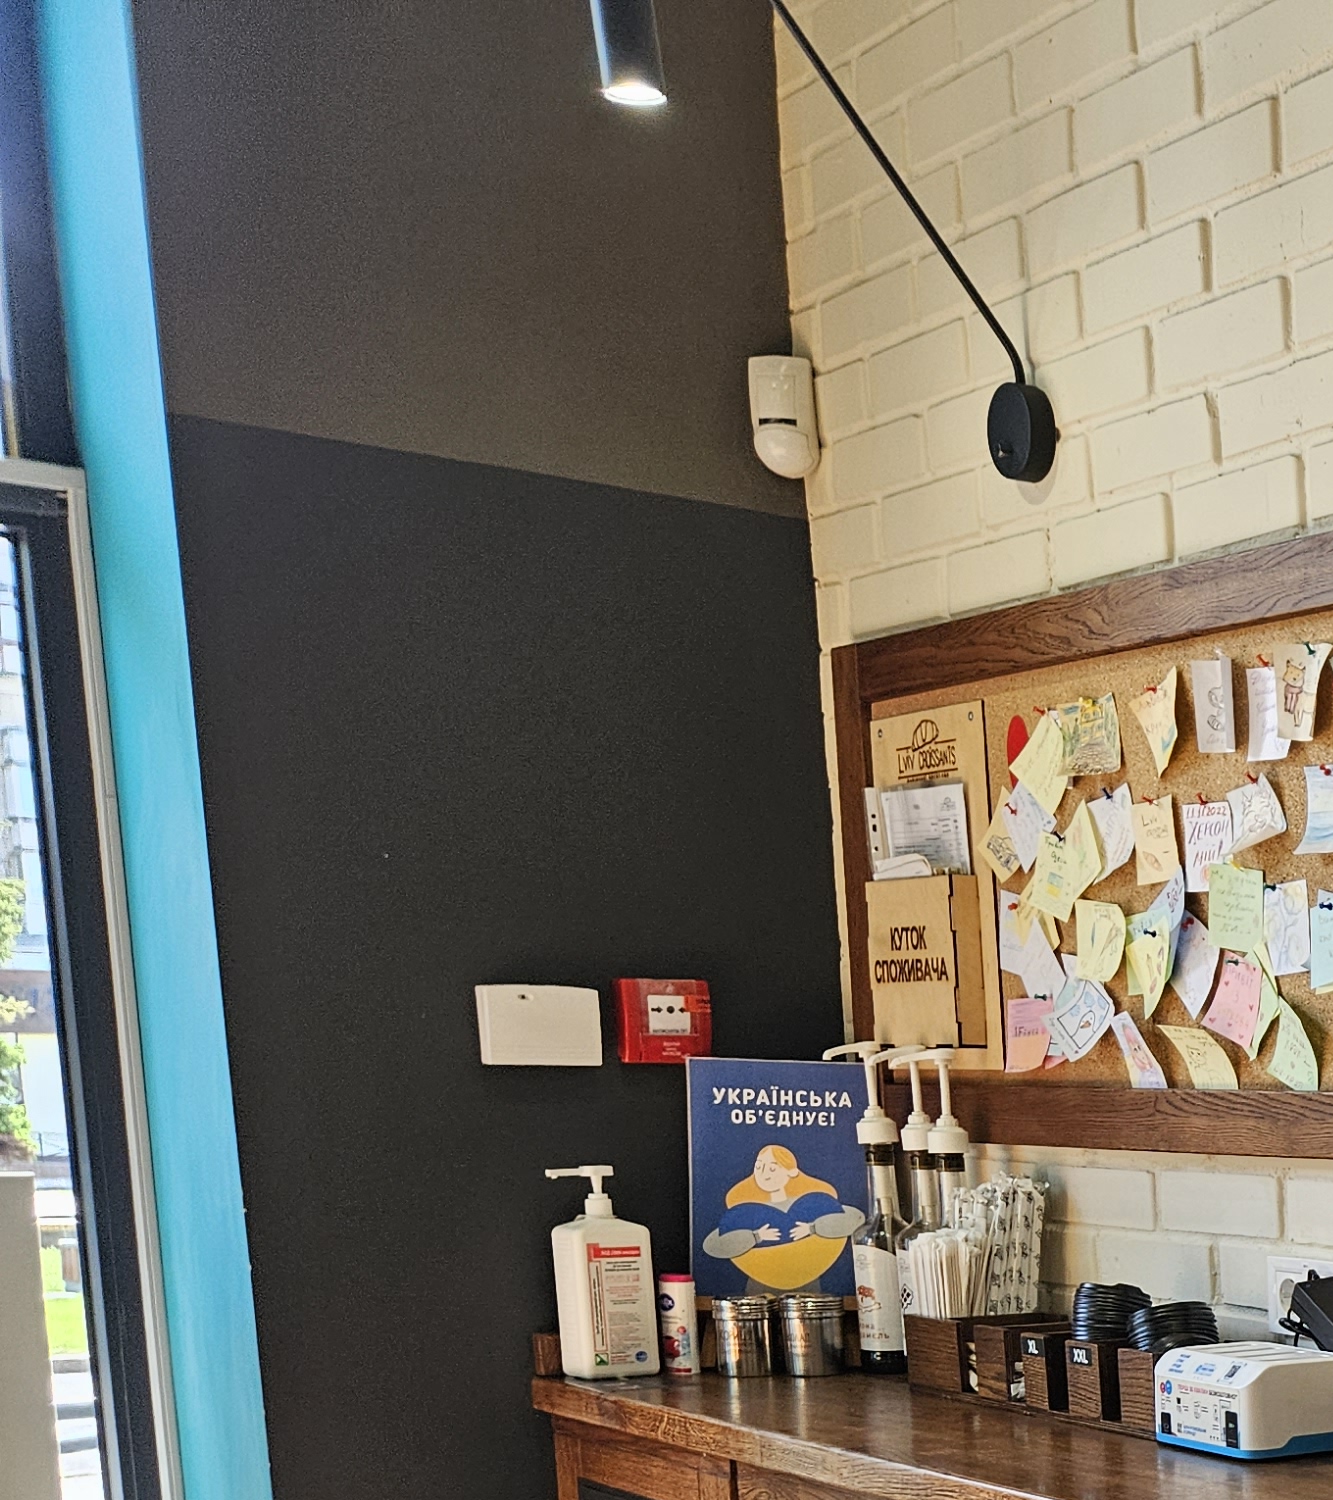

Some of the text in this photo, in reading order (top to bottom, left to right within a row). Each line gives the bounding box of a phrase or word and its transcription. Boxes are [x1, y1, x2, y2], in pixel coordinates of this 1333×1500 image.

[890, 925, 928, 951] КУТОК
[874, 956, 950, 984] СПОЖИВАЧА
[712, 1086, 852, 1108] УКРАЇНСЬКА
[730, 1109, 836, 1128] ОБ'ЄДНУЄ!
[1026, 1340, 1039, 1354] XL
[1072, 1350, 1089, 1365] XXL
